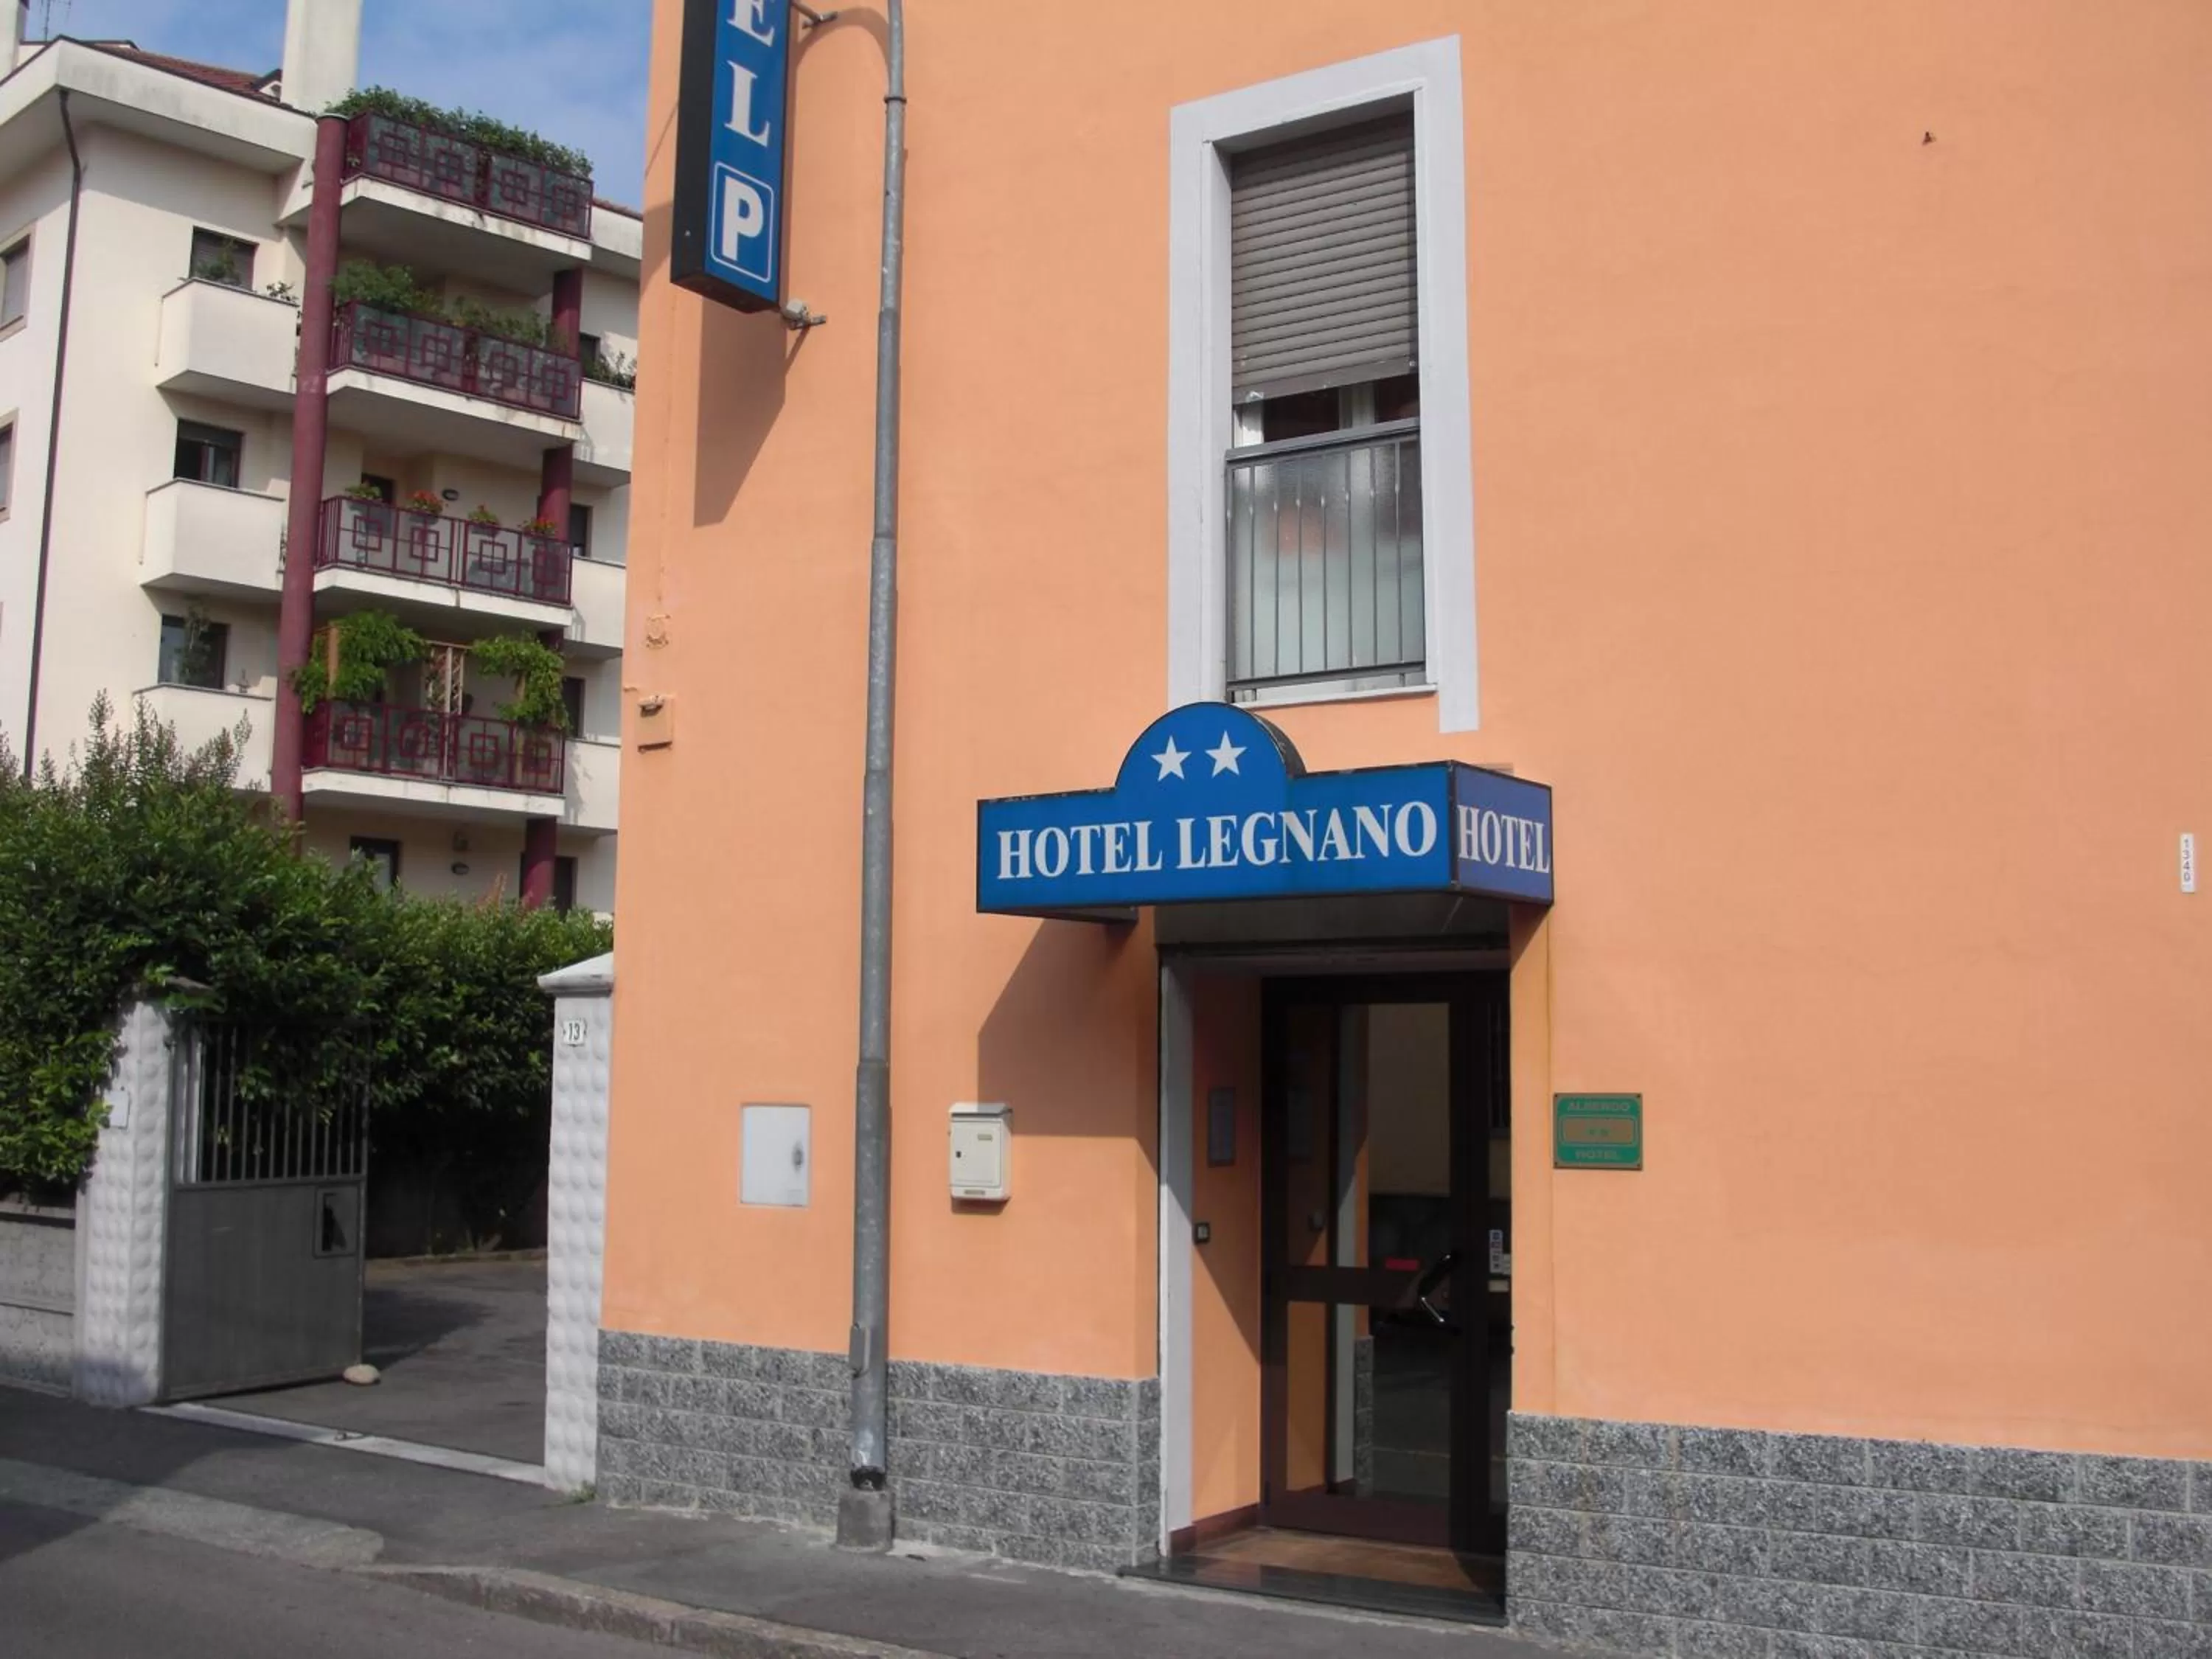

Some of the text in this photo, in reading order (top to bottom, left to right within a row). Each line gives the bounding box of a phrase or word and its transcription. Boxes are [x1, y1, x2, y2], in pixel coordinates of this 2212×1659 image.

[721, 175, 764, 261] P
[997, 801, 1437, 880] HOTEL LEGNANO
[1457, 804, 1550, 874] HOTEL
[568, 1023, 580, 1040] 13
